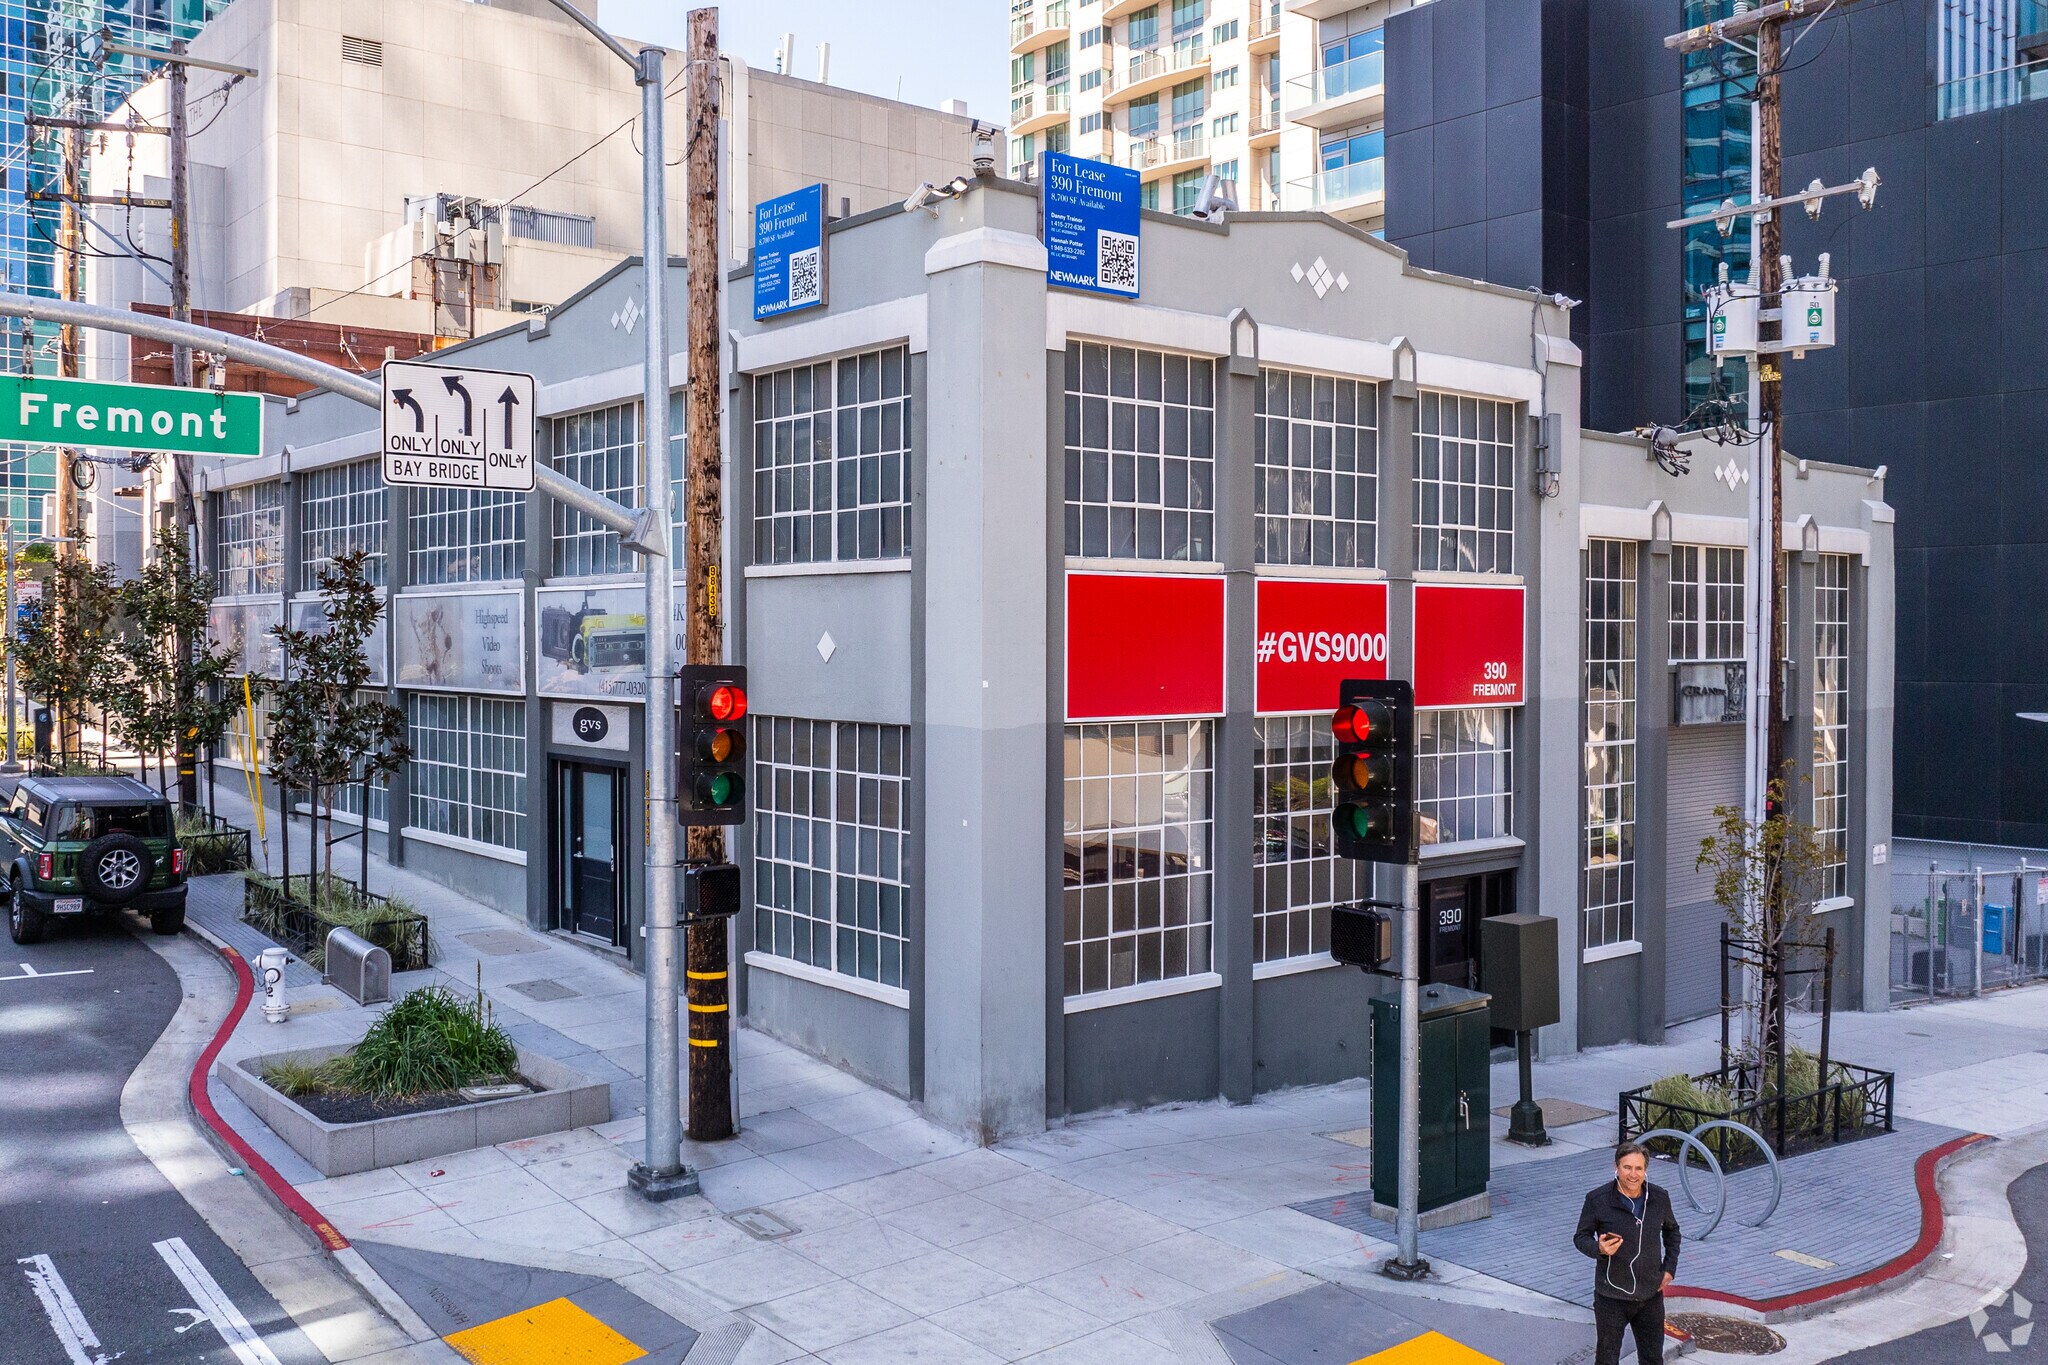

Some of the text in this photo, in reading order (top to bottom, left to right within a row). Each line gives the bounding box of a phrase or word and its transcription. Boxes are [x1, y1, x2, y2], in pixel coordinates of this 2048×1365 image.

[189, 100, 202, 125] THE
[1052, 158, 1106, 182] For Lease
[1051, 175, 1122, 202] 390 Fremont
[760, 201, 796, 221] For Lease
[1069, 196, 1077, 205] SF
[1079, 198, 1106, 210] Available
[759, 212, 808, 235] 390 Fremont
[1051, 212, 1083, 223] Danny Trainor
[777, 229, 795, 240] Available
[1051, 236, 1068, 245] Hannah
[1050, 270, 1095, 286] NEWMARK
[757, 299, 788, 315] NEWMARK
[20, 392, 227, 439] Fremont
[391, 435, 432, 452] ONLY
[441, 439, 481, 455] ONLY
[489, 453, 527, 469] ONLY
[394, 460, 480, 480] BAY BRIDGE
[475, 609, 508, 629] Highspeed
[482, 637, 501, 652] Video
[1257, 631, 1386, 663] #GVS9000
[481, 658, 502, 675] Shoots
[1484, 662, 1507, 680] 390
[1473, 683, 1516, 697] FREMONT
[580, 719, 601, 733] gvs
[1440, 909, 1462, 925] 390
[1440, 924, 1461, 933] FREMONT
